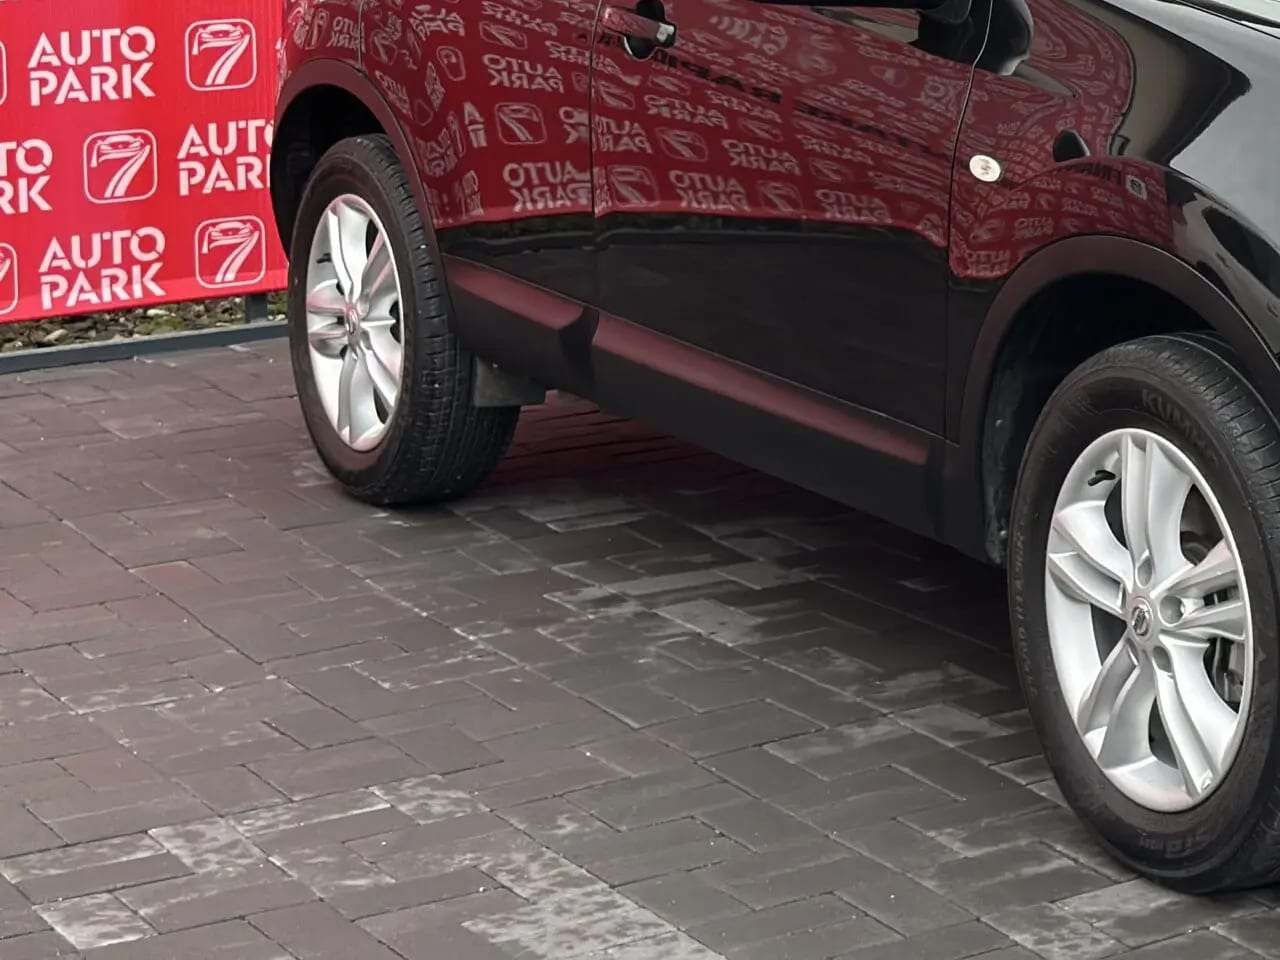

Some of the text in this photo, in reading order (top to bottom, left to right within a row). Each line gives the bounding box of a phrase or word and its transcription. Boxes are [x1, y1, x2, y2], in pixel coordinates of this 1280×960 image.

[28, 26, 155, 68] AUTO
[30, 63, 154, 106] PARK
[179, 154, 270, 195] PAR
[39, 227, 165, 272] AUTO
[41, 263, 165, 309] PARK
